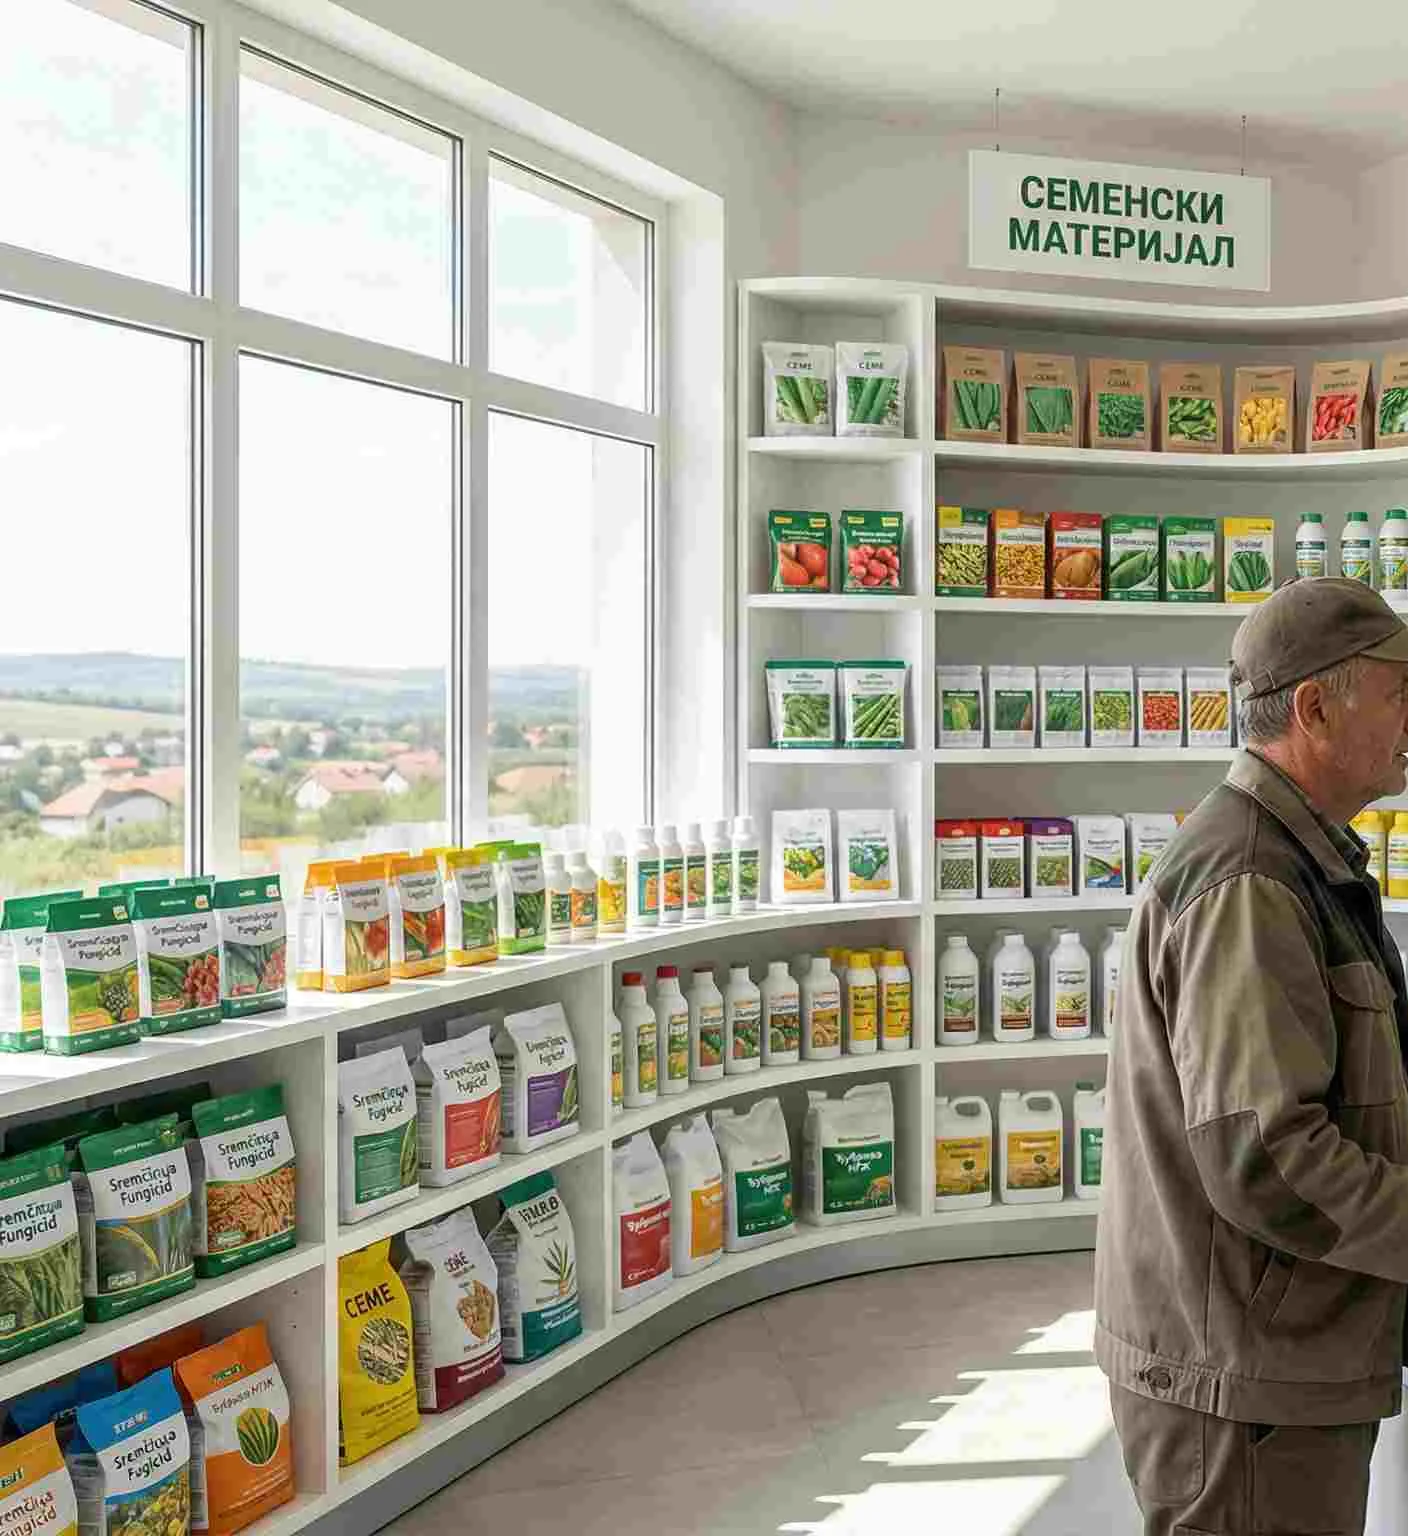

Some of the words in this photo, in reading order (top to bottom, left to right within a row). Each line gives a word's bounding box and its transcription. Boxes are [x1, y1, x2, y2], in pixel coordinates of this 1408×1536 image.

[1020, 175, 1224, 225] СЕМЕНСКИ
[1008, 217, 1235, 268] МАТЕРИЈАЛ
[344, 1282, 395, 1318] СЕМЕ
